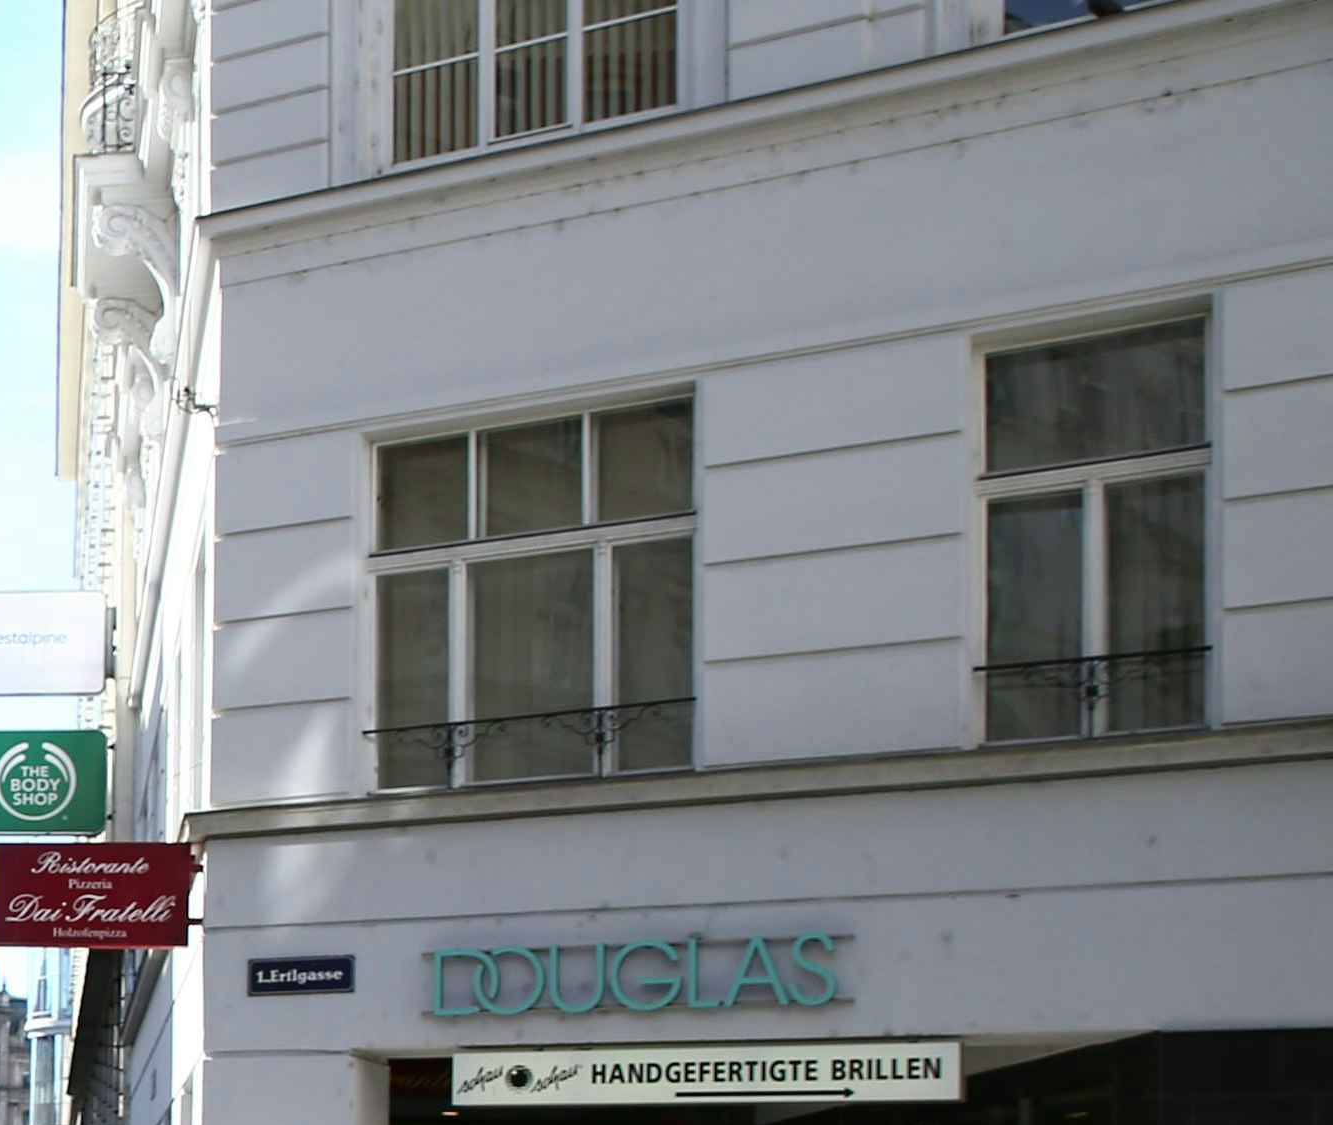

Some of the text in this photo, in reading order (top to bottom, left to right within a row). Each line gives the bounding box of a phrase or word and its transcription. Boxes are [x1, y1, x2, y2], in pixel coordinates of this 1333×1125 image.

[20, 765, 49, 778] THE
[9, 778, 61, 792] BODY
[12, 793, 59, 806] SHOP
[30, 850, 150, 875] Ristorante
[67, 878, 113, 890] Pizzeria
[4, 892, 177, 924] Dai Fratelli
[52, 926, 128, 940] Holzofenpizza
[432, 931, 839, 1017] DOUGLAS
[591, 1058, 819, 1085] HANDGEFERTIGTE
[830, 1056, 943, 1082] BRILLEN
